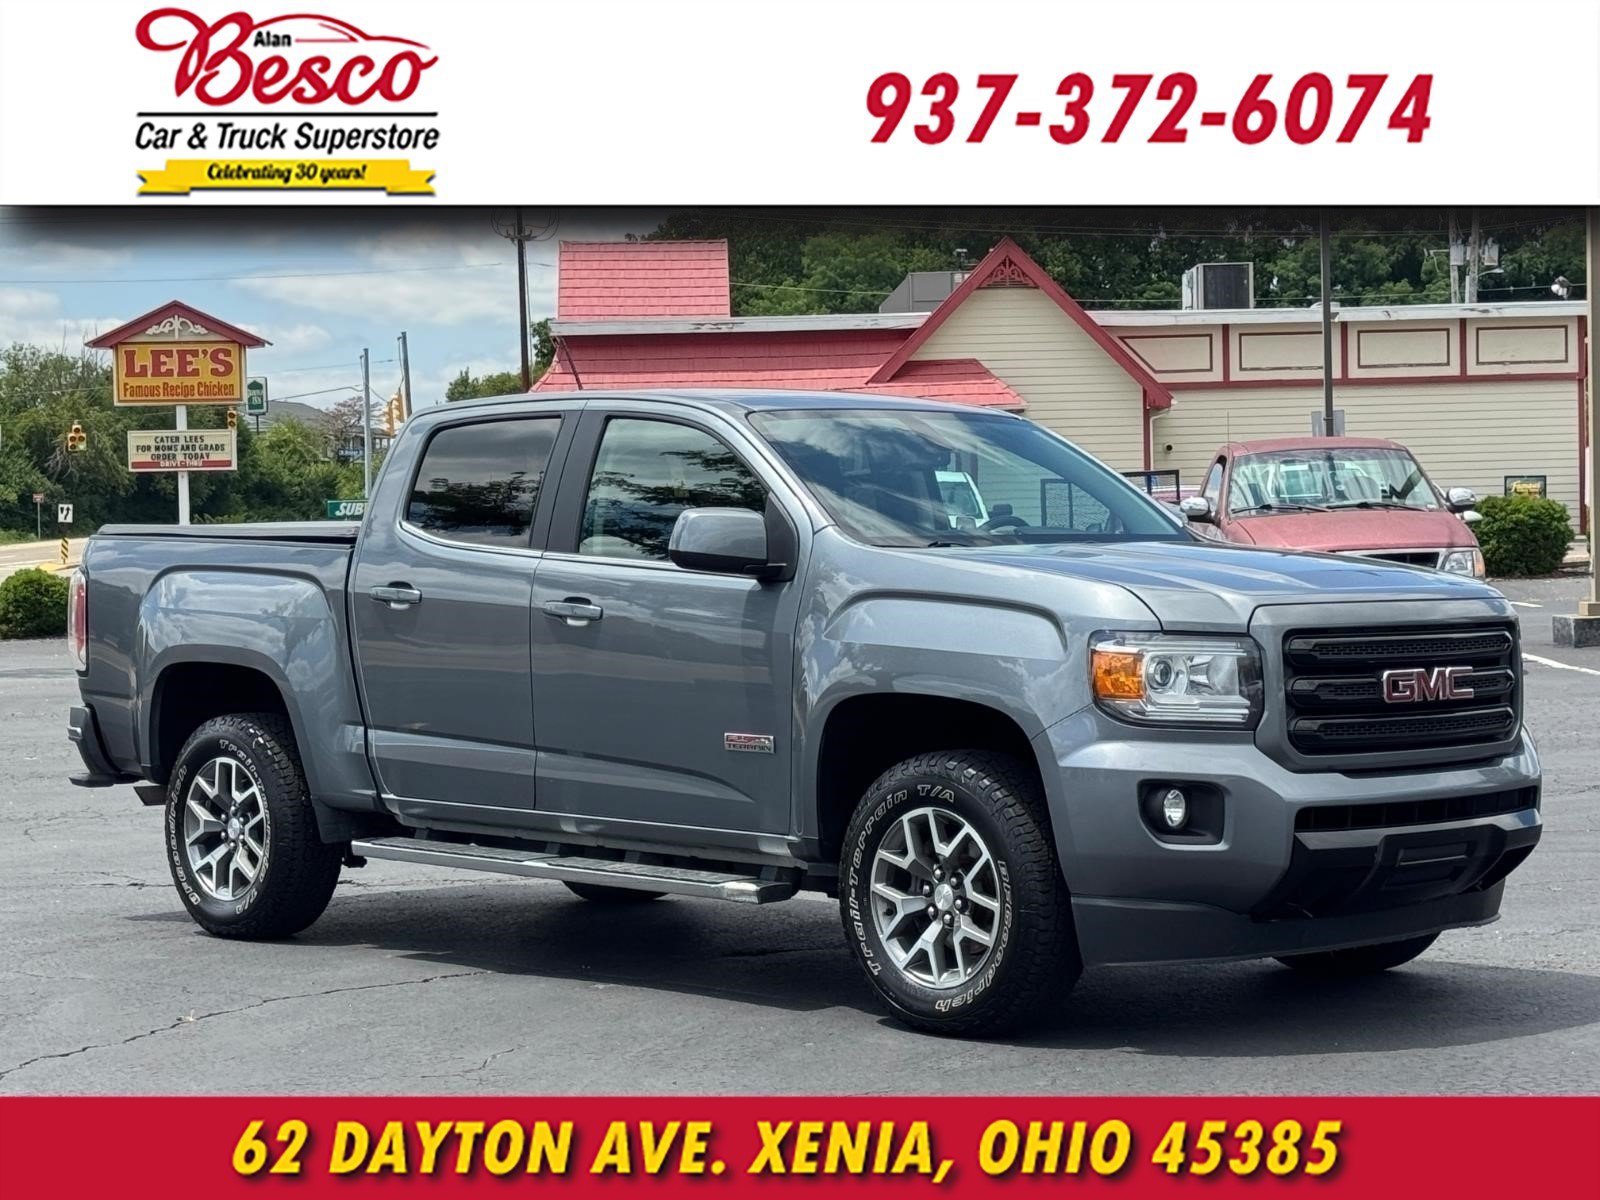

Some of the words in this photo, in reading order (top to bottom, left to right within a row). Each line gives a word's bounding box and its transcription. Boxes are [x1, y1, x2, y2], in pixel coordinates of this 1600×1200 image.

[123, 348, 234, 378] LEE'S
[123, 382, 161, 397] Famous
[162, 382, 195, 398] Recipe
[197, 381, 234, 397] Chicken
[154, 435, 180, 443] CATER
[184, 435, 204, 443] LEES
[136, 445, 151, 453] FOR
[154, 444, 178, 452] MOMS
[180, 444, 196, 452] AND
[198, 443, 225, 451] GRADS
[183, 452, 210, 460] TODAY
[335, 502, 368, 516] SUB
[1383, 666, 1475, 704] GMC
[849, 788, 908, 976] Trail-Terrain
[917, 784, 955, 803] T/A
